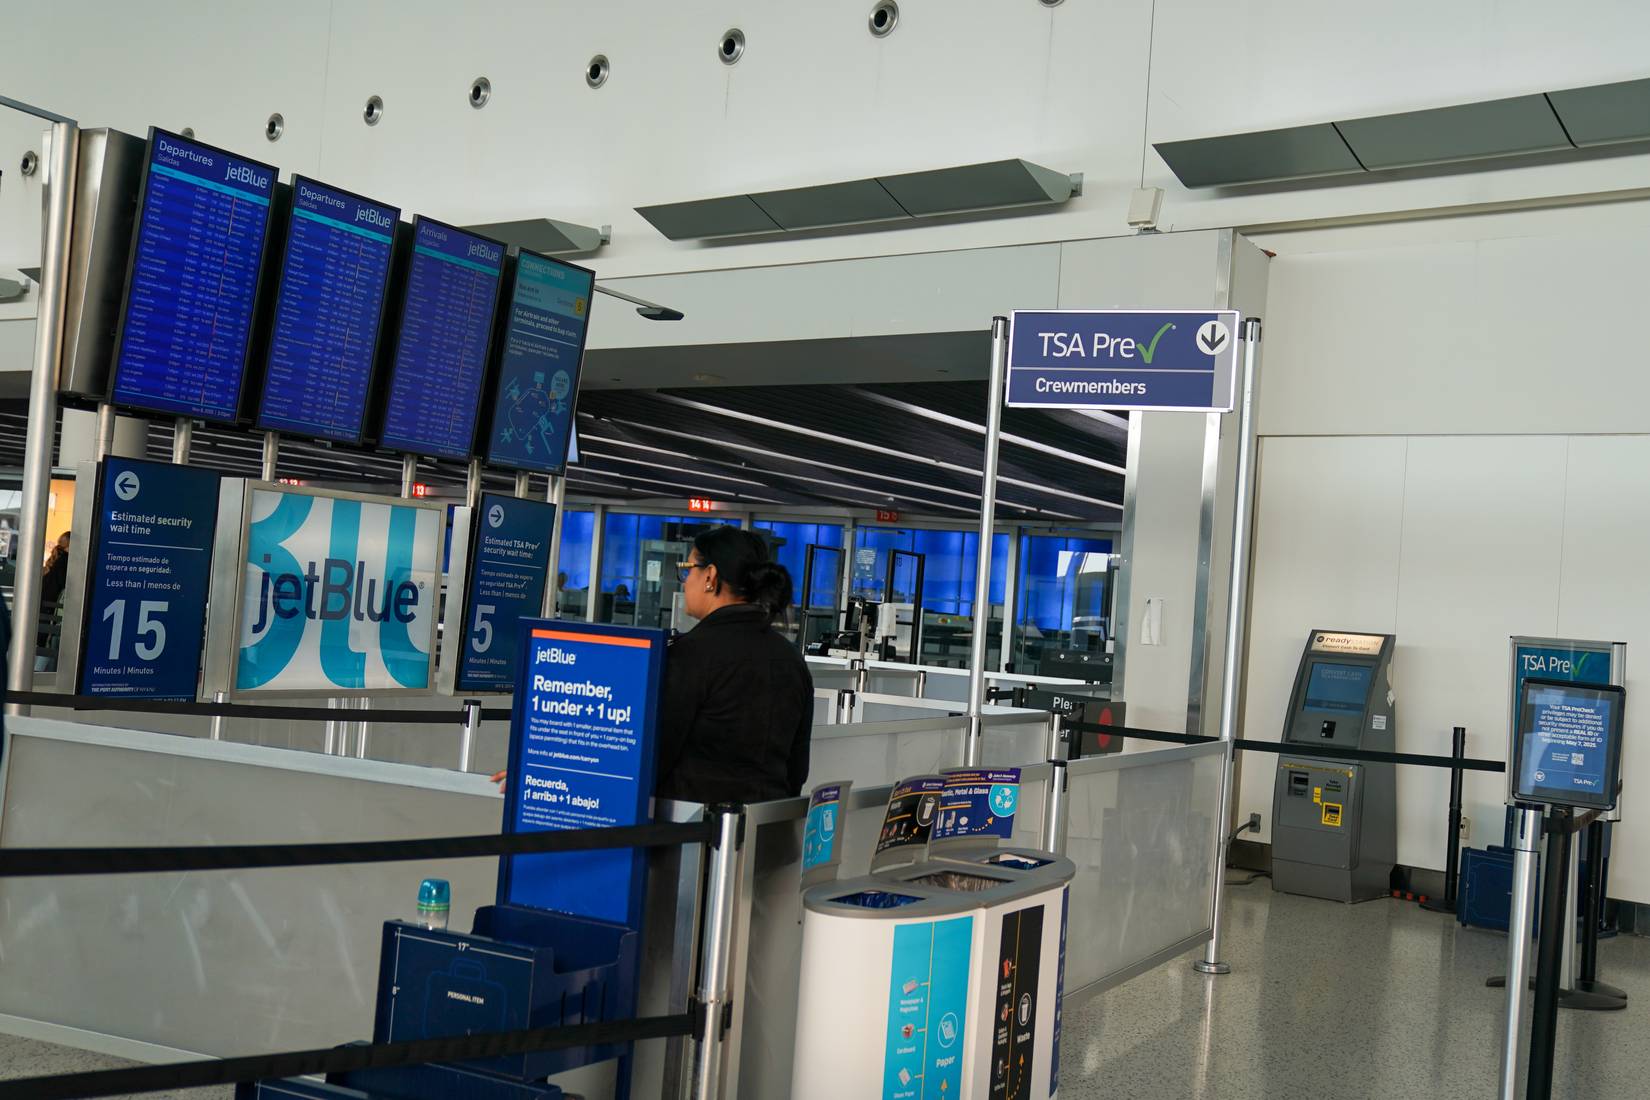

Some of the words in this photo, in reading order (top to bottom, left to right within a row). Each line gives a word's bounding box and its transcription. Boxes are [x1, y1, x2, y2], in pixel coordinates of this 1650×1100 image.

[158, 154, 180, 166] Salidas
[160, 140, 213, 166] Departures
[225, 162, 268, 188] jetBlue
[300, 186, 345, 208] Departures
[355, 205, 391, 228] jetBlue
[420, 226, 447, 240] Arrivals
[467, 241, 498, 261] jetBlue
[1038, 332, 1085, 358] TSA
[1093, 333, 1136, 358] Pre
[1036, 377, 1146, 394] Crewmembers
[690, 499, 700, 508] 14
[110, 523, 128, 534] wait
[131, 525, 150, 535] time
[112, 511, 155, 524] Estimated
[157, 517, 192, 529] security
[485, 536, 512, 547] Estimated
[107, 553, 130, 563] Tiempo
[132, 556, 160, 564] estimado
[484, 547, 506, 557] security
[106, 564, 127, 572] espera
[106, 578, 123, 587] Less
[125, 580, 141, 589] than
[172, 582, 181, 590] de
[252, 553, 419, 634] jetBlue
[102, 599, 169, 661] 15
[472, 604, 496, 653] 5
[536, 646, 576, 665] jetBlue
[1522, 655, 1546, 671] TSA
[1549, 657, 1571, 673] Pre
[533, 675, 613, 701] Remember,
[532, 695, 539, 711] 1
[541, 699, 583, 716] under
[586, 705, 594, 716] +
[598, 703, 604, 719] 1
[607, 706, 631, 725] up!
[525, 775, 568, 792] Recuerda,
[532, 790, 557, 802] arriba
[566, 794, 570, 804] 1
[572, 796, 599, 810] abajo!
[448, 991, 472, 1001] PERSONAL
[1017, 1032, 1030, 1043] Waste
[936, 1056, 955, 1068] Paper
